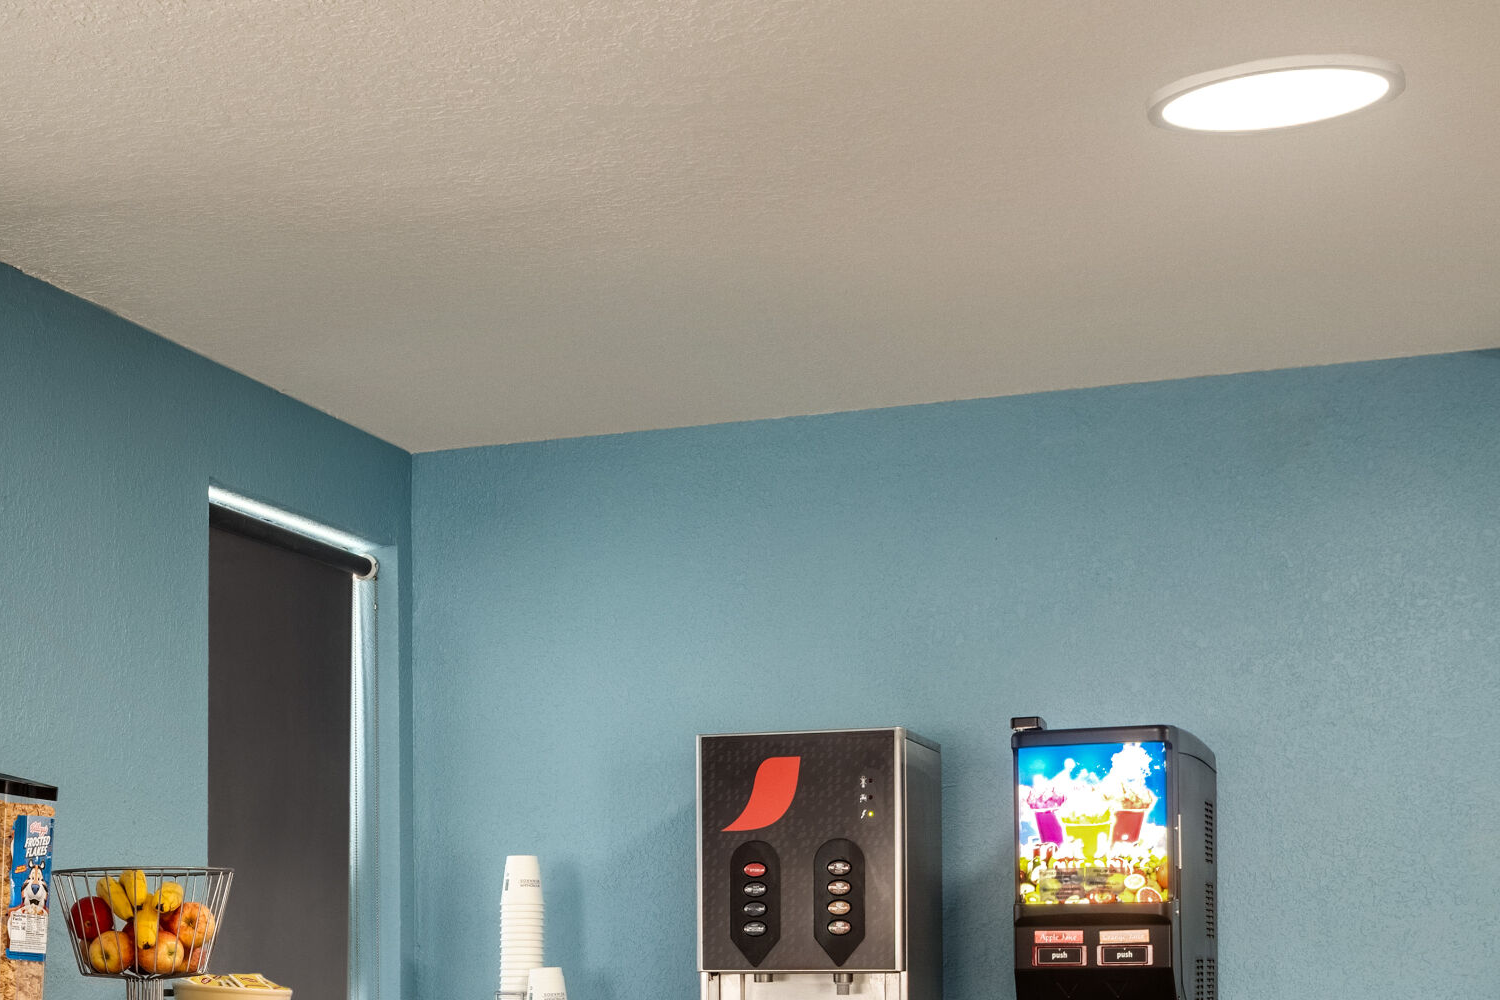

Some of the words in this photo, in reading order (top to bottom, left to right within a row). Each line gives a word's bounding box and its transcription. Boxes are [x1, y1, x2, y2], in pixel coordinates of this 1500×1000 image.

[24, 836, 51, 848] FROSTED
[26, 846, 48, 858] FLAKES
[1040, 933, 1058, 942] Apple
[1051, 951, 1068, 960] push
[1116, 950, 1133, 960] push
